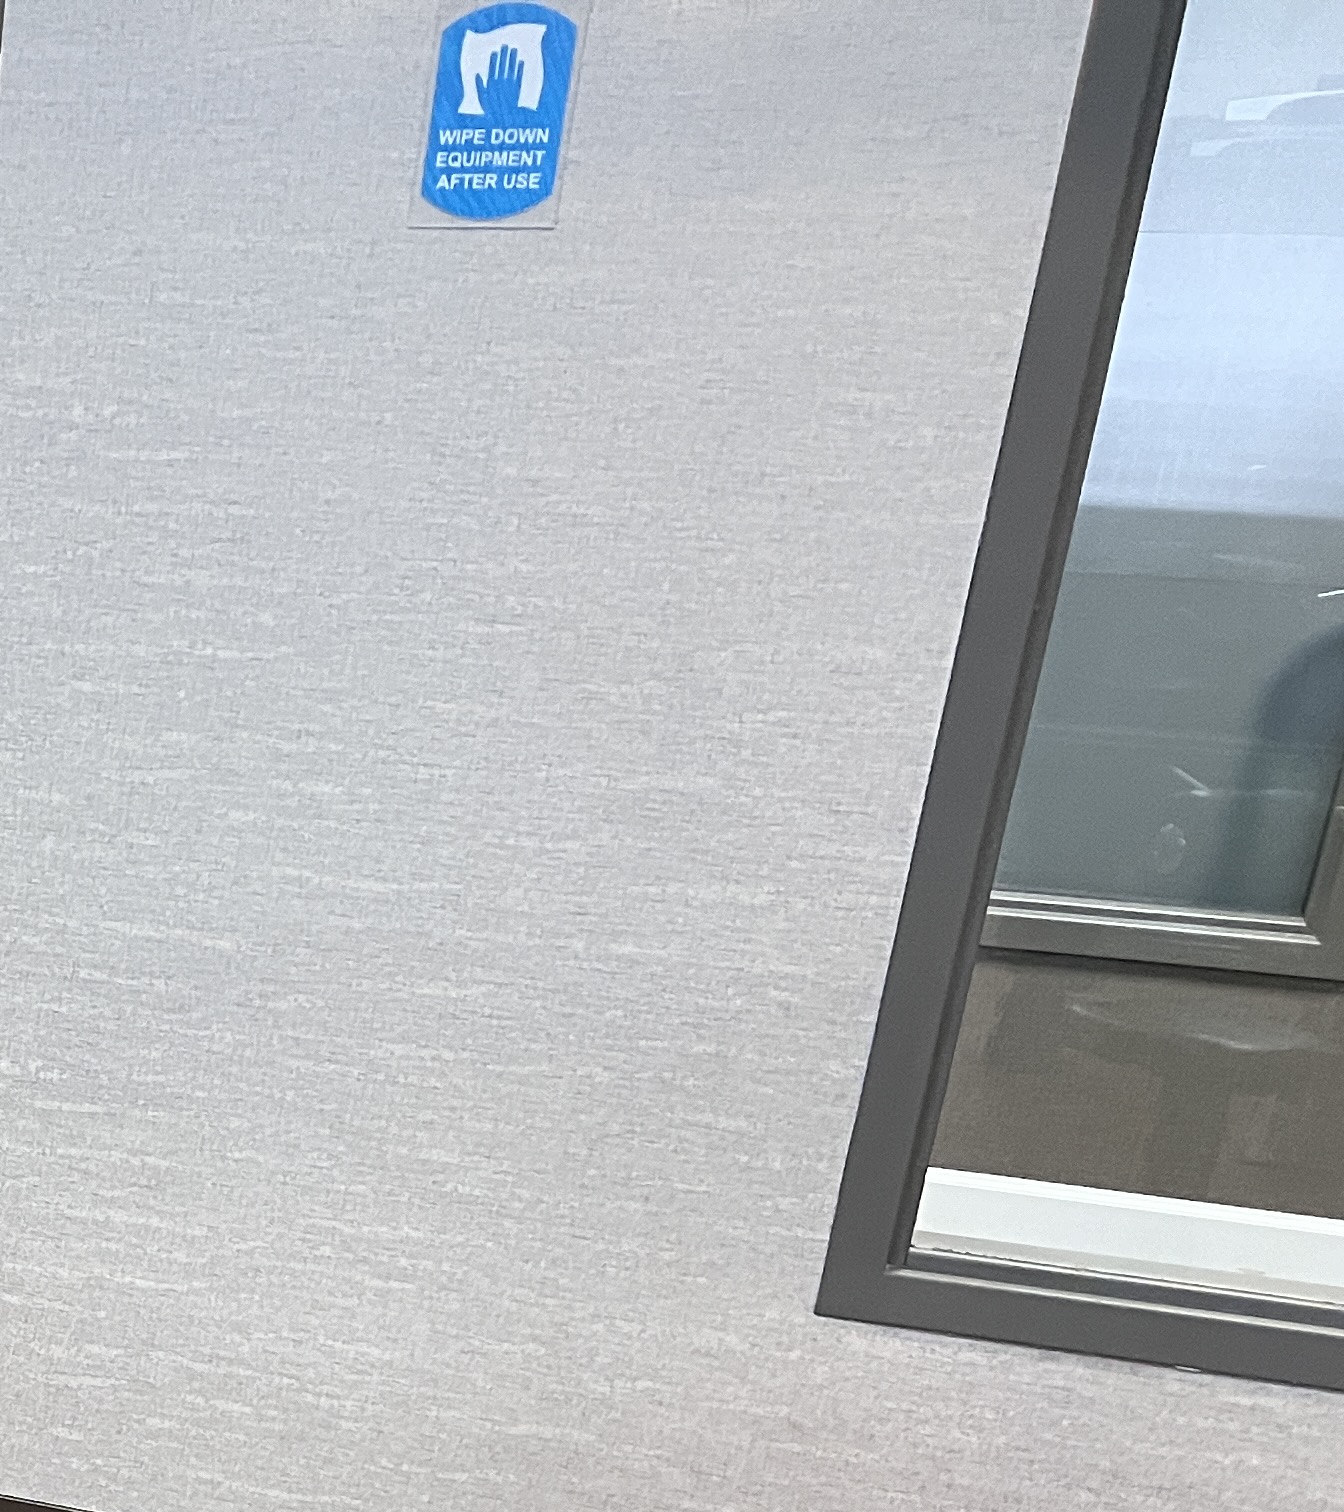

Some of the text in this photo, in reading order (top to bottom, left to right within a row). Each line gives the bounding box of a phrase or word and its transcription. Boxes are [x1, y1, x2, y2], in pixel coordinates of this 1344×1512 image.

[438, 128, 549, 146] WIPE DOWN
[435, 150, 546, 168] EQUIPMENT
[435, 172, 542, 190] AFTER USE
